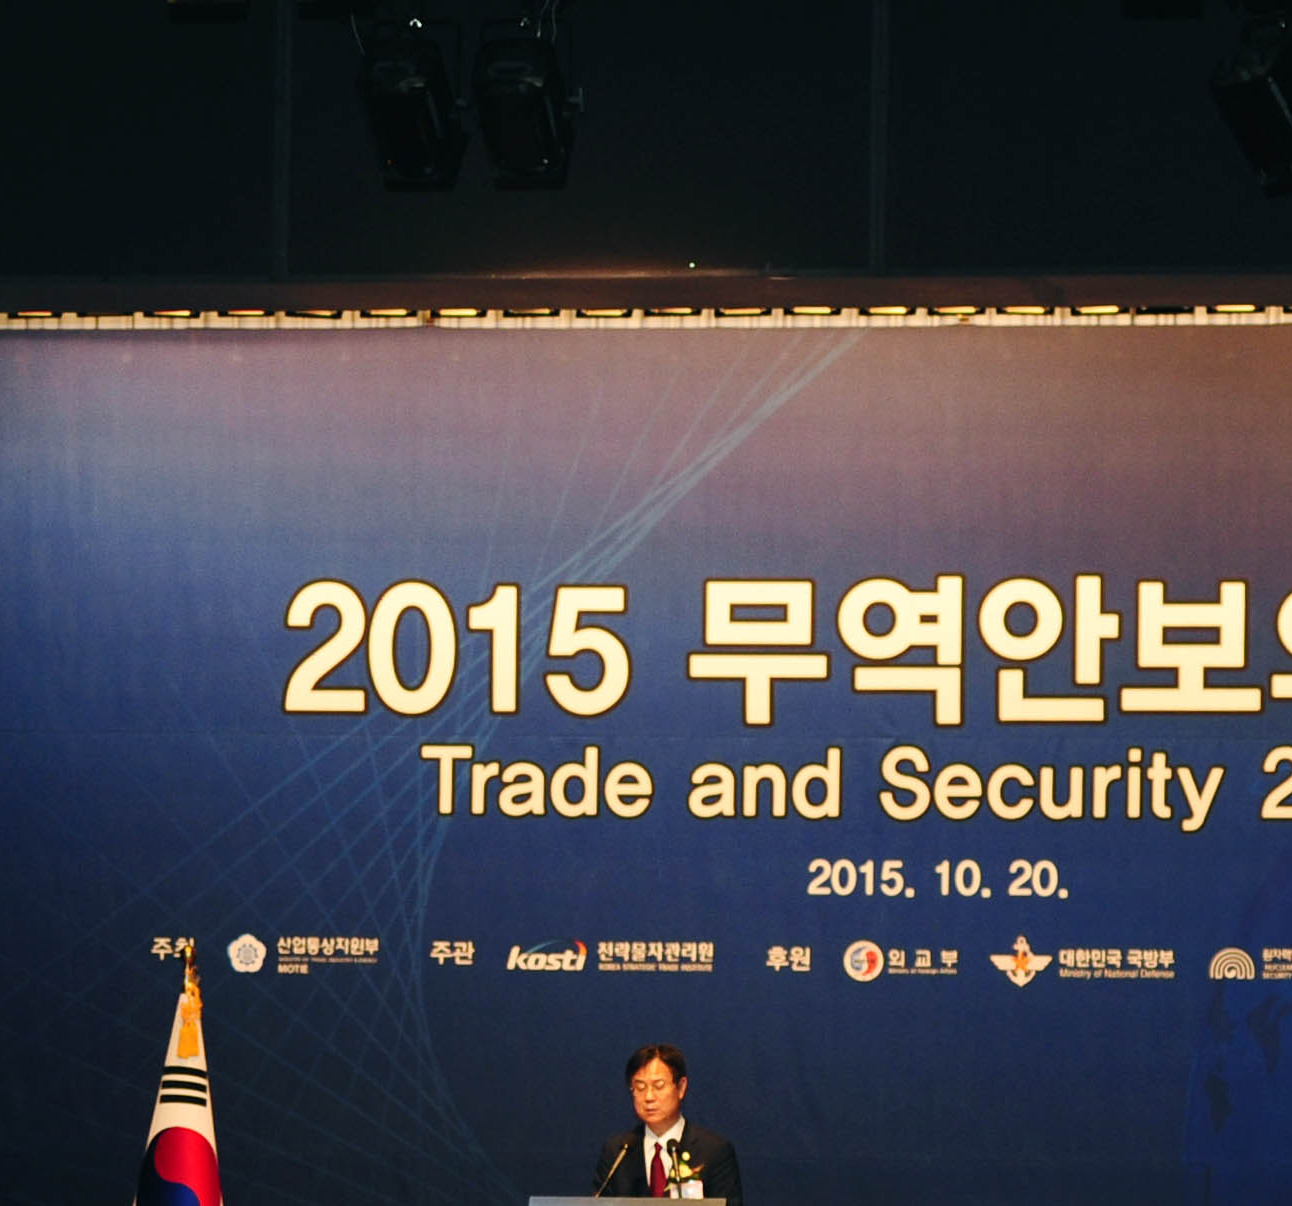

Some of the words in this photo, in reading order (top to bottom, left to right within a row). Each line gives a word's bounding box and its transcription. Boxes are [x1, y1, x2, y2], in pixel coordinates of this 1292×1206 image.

[282, 578, 633, 717] 2015
[419, 743, 654, 819] Trade
[687, 746, 843, 820] and
[878, 744, 1226, 833] Security
[806, 857, 916, 899] 2015.
[934, 858, 993, 899] 10.
[1007, 858, 1070, 899] 20.
[429, 940, 475, 966] 주관
[765, 945, 812, 972] 후원
[1058, 949, 1123, 969] 대한민국
[1127, 949, 1175, 969] 국방부
